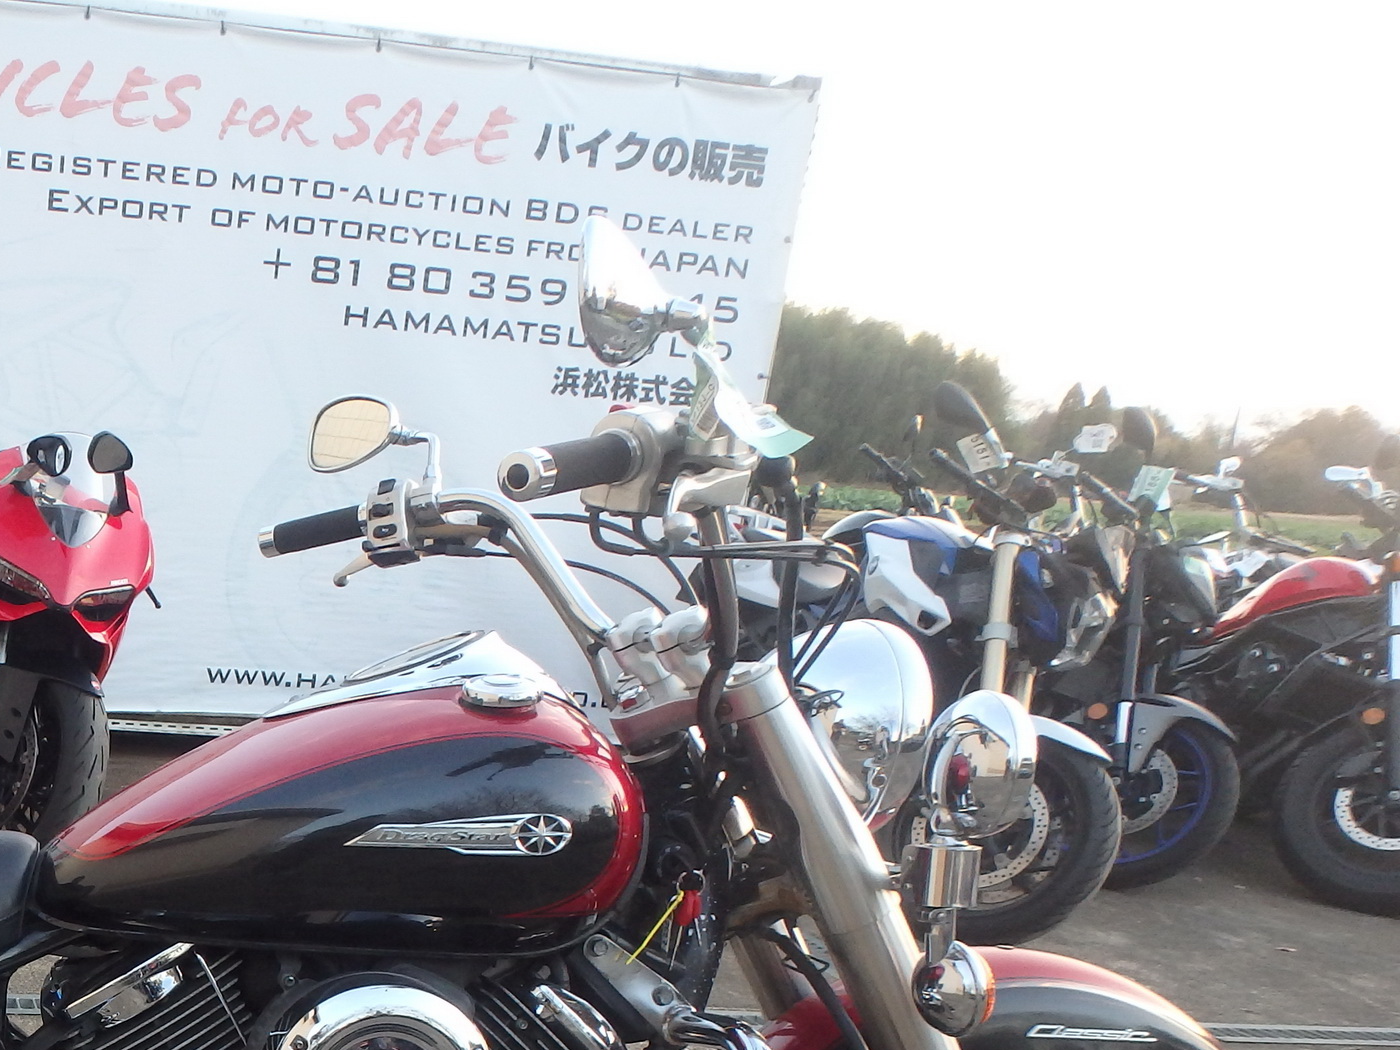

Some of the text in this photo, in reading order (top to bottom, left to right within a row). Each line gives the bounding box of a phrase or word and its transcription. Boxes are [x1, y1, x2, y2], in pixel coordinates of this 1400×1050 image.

[333, 93, 519, 167] SALE
[534, 122, 769, 188] バイクの販売
[47, 188, 192, 224] EXPORT
[210, 207, 256, 229] OF
[265, 213, 515, 255] MOTORCYCLES
[526, 239, 580, 262] FRO
[231, 171, 511, 218] MOTO-AUCTION
[622, 212, 754, 245] DEALER
[263, 247, 292, 280] +
[310, 255, 361, 287] 81
[386, 262, 452, 295] 80
[468, 271, 568, 306] 359
[343, 304, 587, 349] HAMAMATSU
[551, 366, 695, 406] 浜松株式会
[1025, 1023, 1159, 1043] Classic
